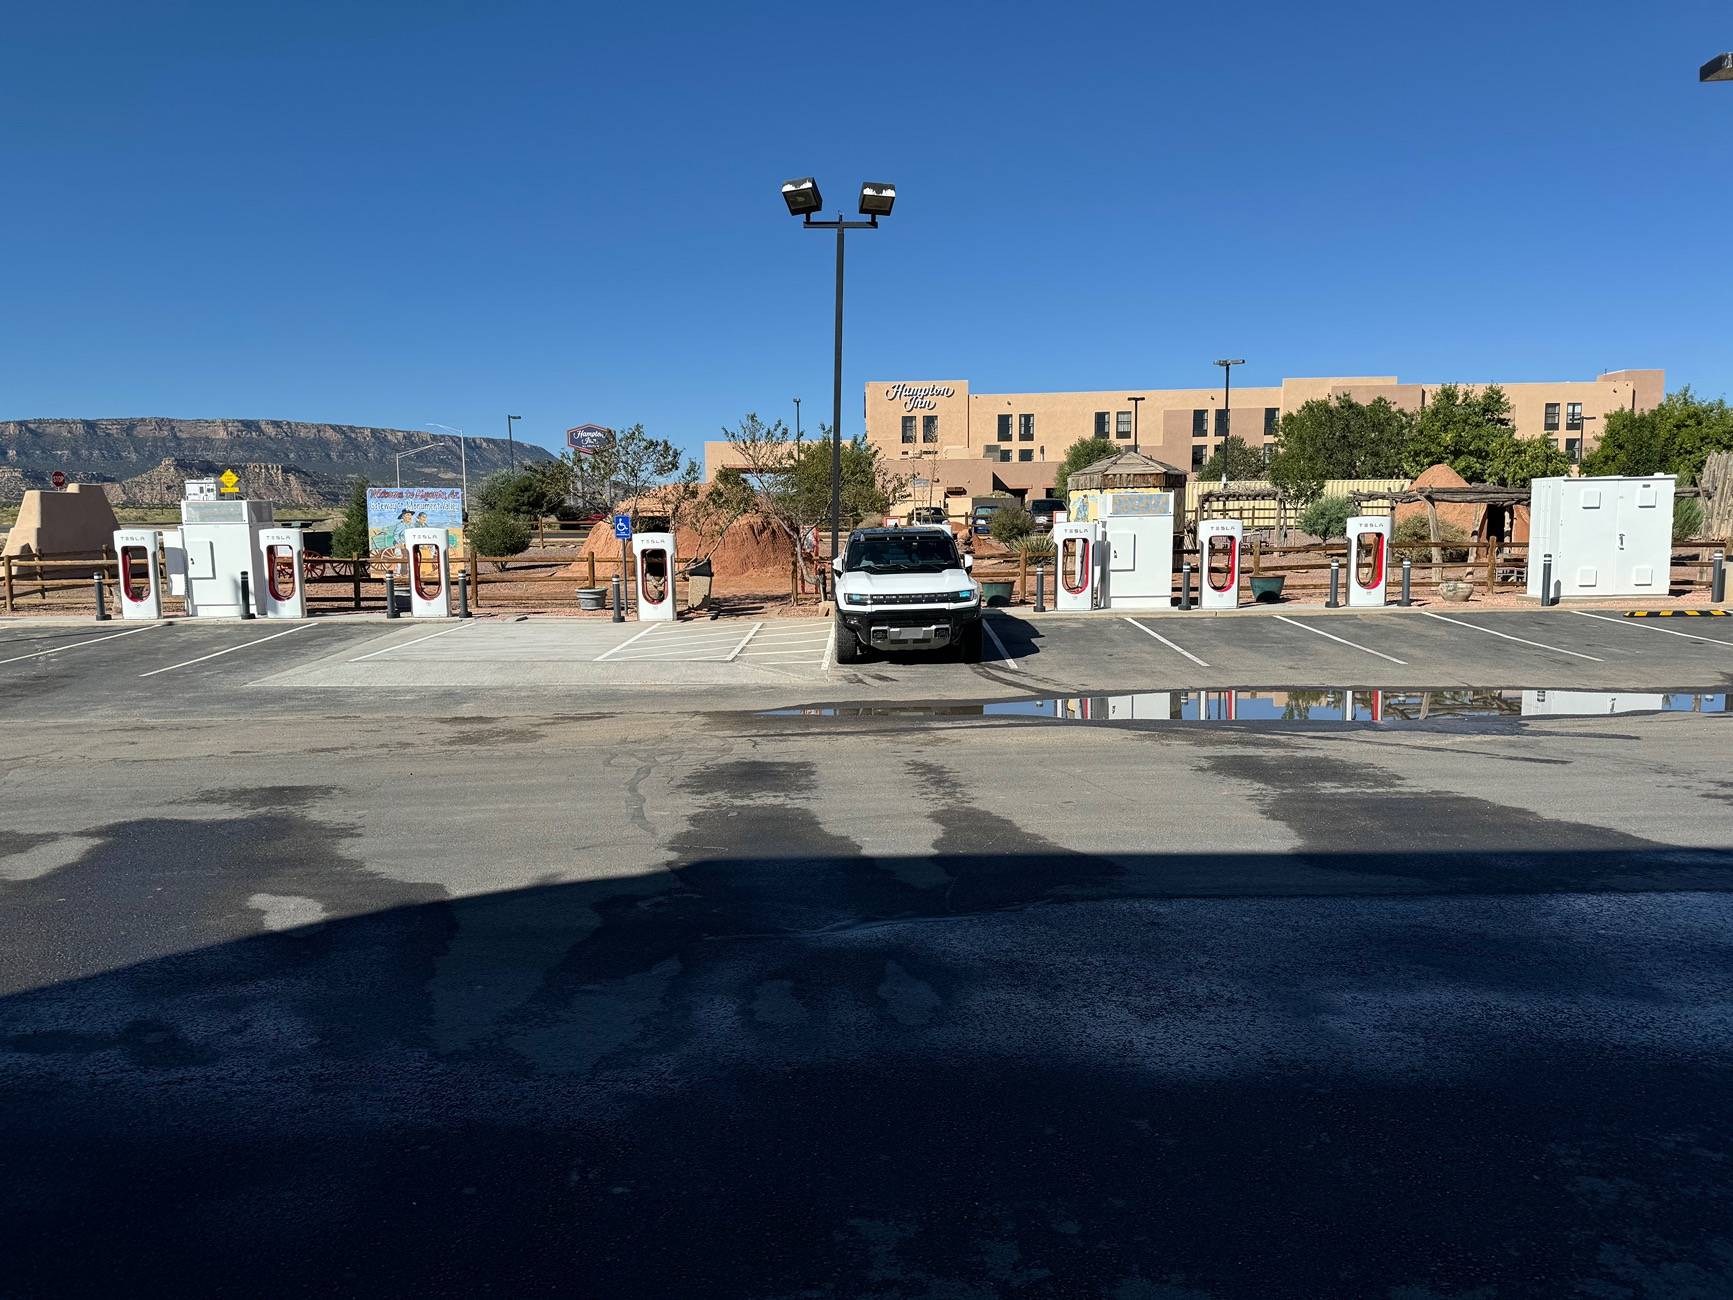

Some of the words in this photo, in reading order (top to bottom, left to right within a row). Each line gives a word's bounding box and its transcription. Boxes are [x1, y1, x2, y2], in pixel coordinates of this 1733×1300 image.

[885, 383, 955, 401] Hampton
[904, 396, 937, 412] Inn
[573, 430, 607, 439] Hampton
[53, 475, 65, 483] STOP
[371, 489, 404, 499] Welcome
[370, 501, 397, 511] Gateway
[406, 501, 440, 511] Monument
[440, 501, 459, 511] Valley
